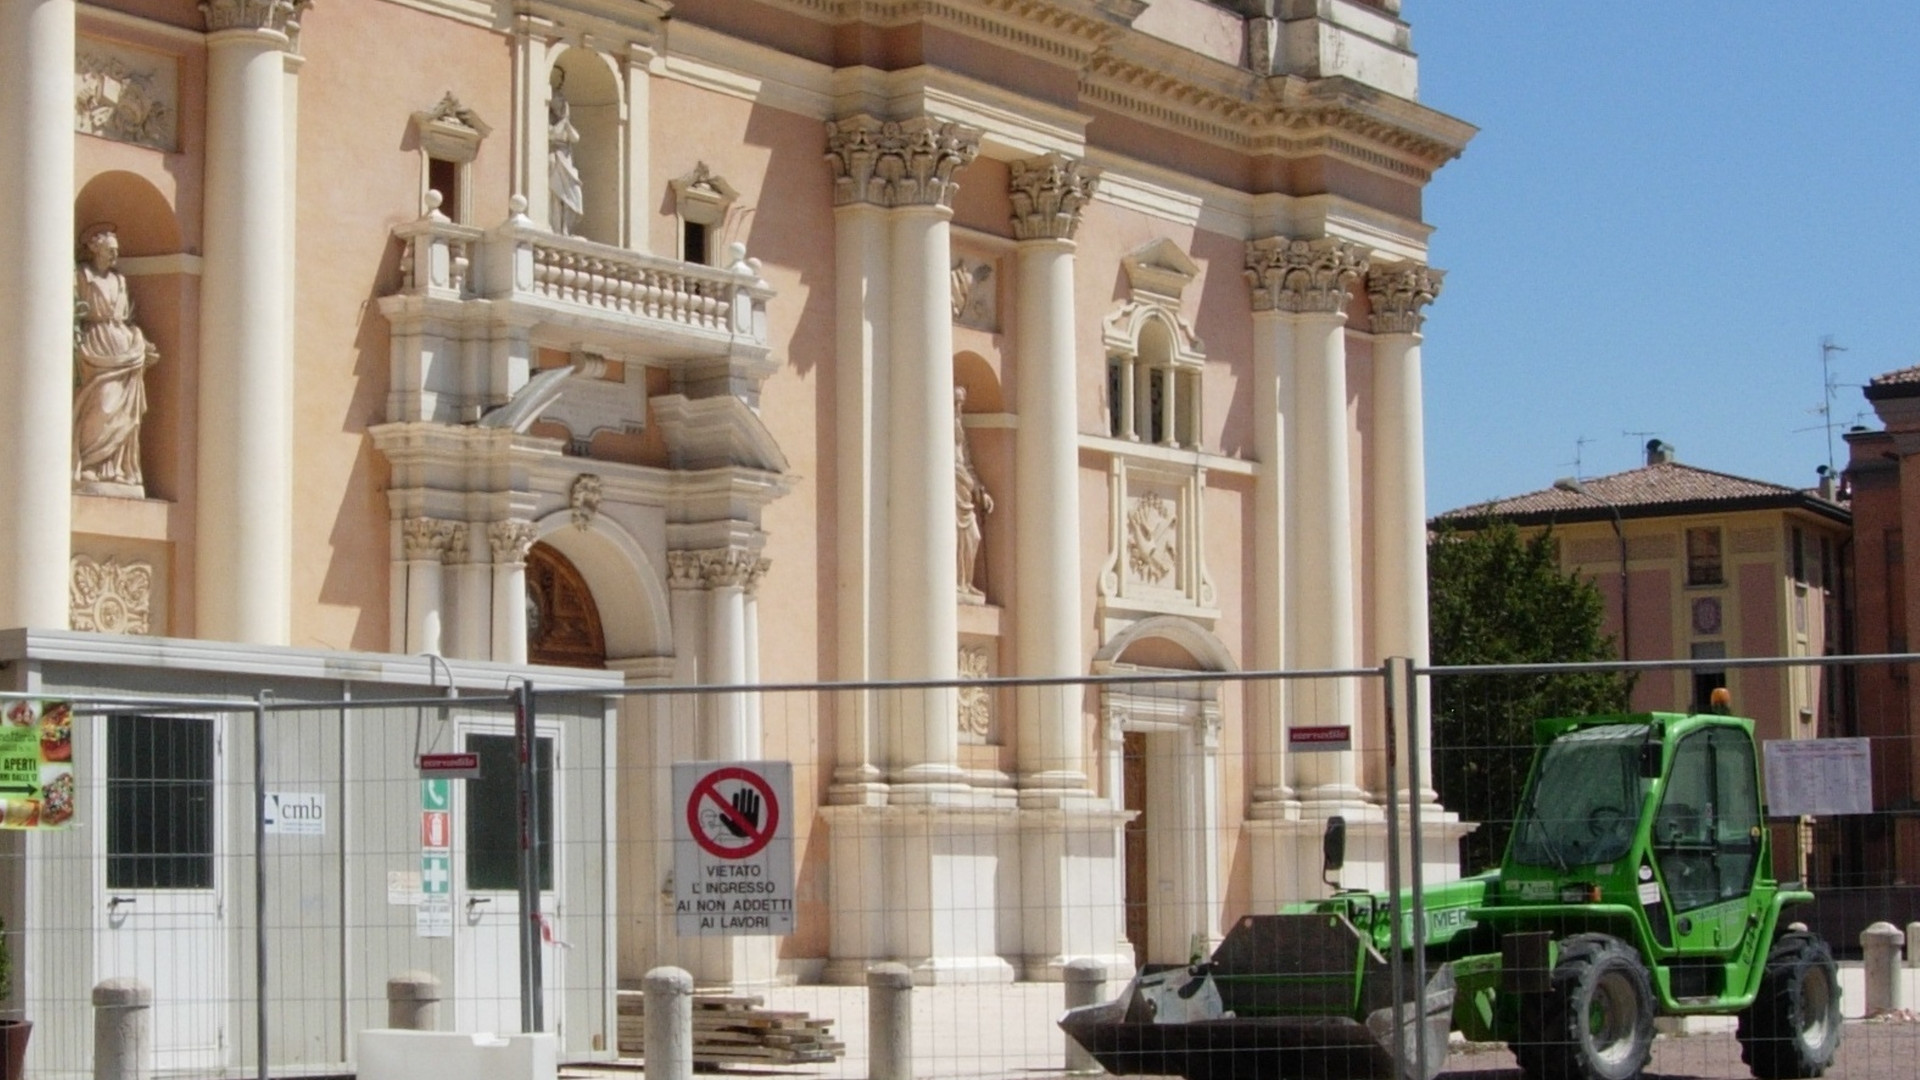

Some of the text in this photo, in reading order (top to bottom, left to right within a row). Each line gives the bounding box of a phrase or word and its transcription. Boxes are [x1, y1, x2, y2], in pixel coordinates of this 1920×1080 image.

[4, 758, 36, 771] APERTI
[282, 797, 322, 820] cmb
[706, 865, 761, 877] VIETATO
[706, 882, 775, 894] INGRESSO
[677, 899, 792, 911] AI NON ADDETTI
[701, 916, 769, 928] AI LAVORI
